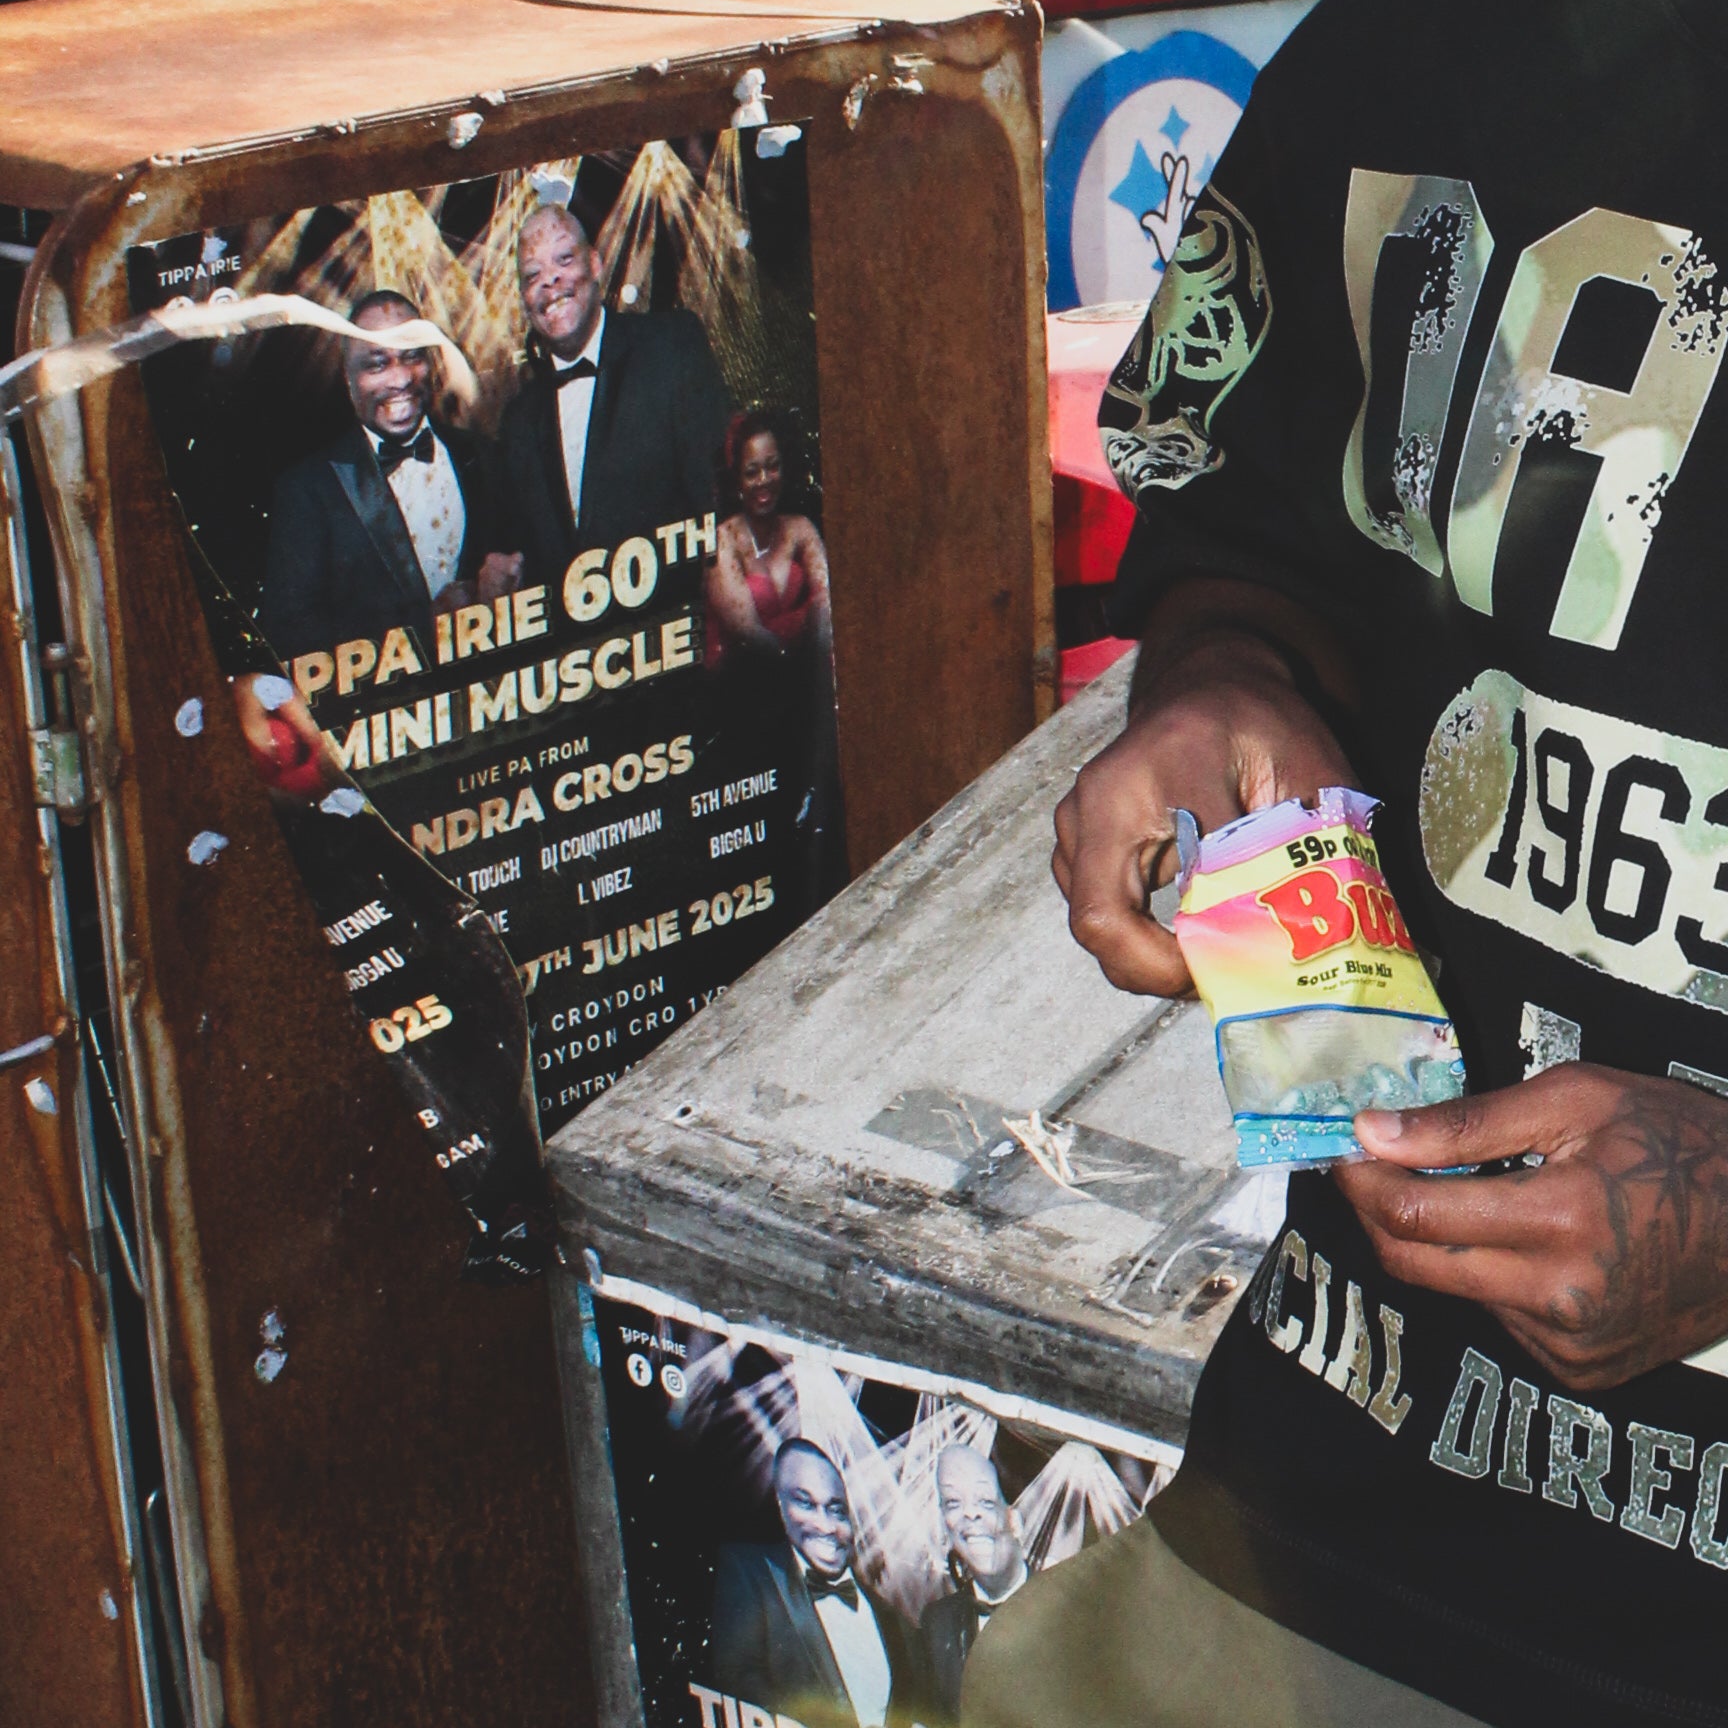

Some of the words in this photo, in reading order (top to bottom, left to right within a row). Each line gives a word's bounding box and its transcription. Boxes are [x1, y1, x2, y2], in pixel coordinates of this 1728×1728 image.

[158, 263, 208, 287] TIPPA
[210, 255, 242, 276] IRIE
[434, 584, 549, 666] IRIE
[562, 512, 719, 624] 60TH
[468, 617, 695, 734] MUSCLE
[411, 784, 547, 857] NDRA
[552, 735, 696, 813] CROSS
[457, 764, 502, 794] LIVE
[506, 755, 534, 778] PA
[538, 737, 590, 768] FROM
[467, 856, 522, 895] TOUCH
[559, 808, 663, 862] COUNTRYMAN
[690, 786, 720, 817] 5TH
[722, 769, 779, 809] AVENUE
[590, 868, 633, 900] VIBEZ
[710, 826, 752, 859] BIGGA
[582, 908, 683, 975] JUNE
[690, 876, 775, 937] 2025
[551, 975, 666, 1033] CROYDON
[1297, 966, 1339, 988] Sour
[1344, 959, 1374, 977] Blue
[559, 1070, 618, 1108] ENTRY
[618, 1326, 660, 1349] TIPPA
[660, 1337, 688, 1358] IRIE
